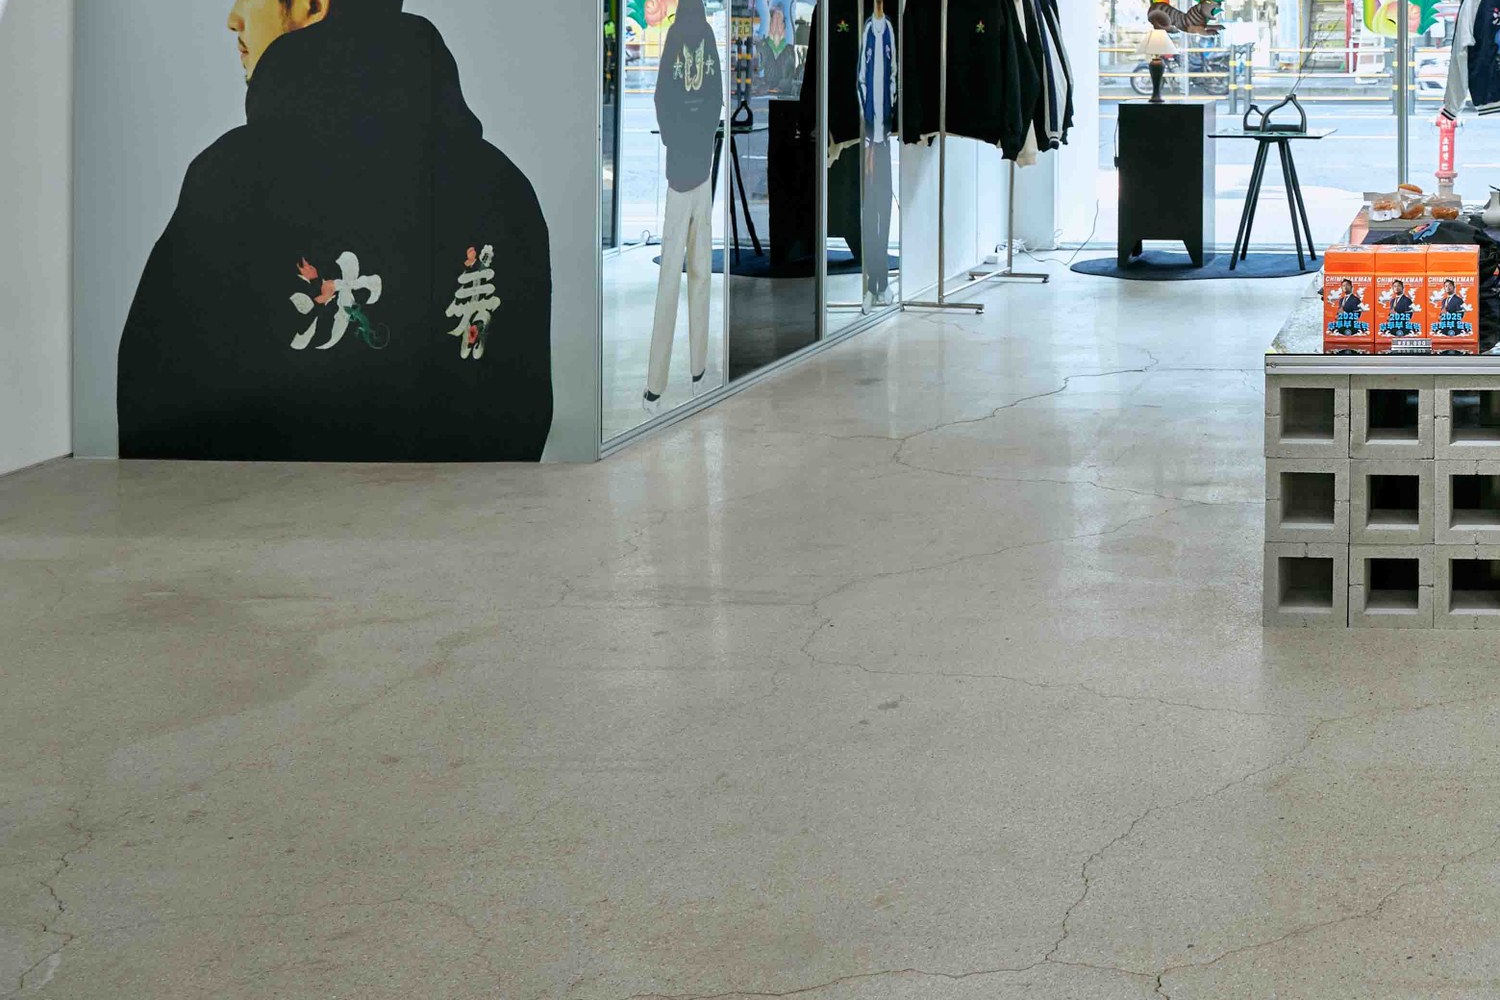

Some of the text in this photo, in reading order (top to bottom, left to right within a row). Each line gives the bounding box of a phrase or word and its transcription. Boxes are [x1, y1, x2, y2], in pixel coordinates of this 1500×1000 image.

[1338, 312, 1359, 320] 2025
[1389, 313, 1411, 321] 2025
[1441, 312, 1462, 320] 2025
